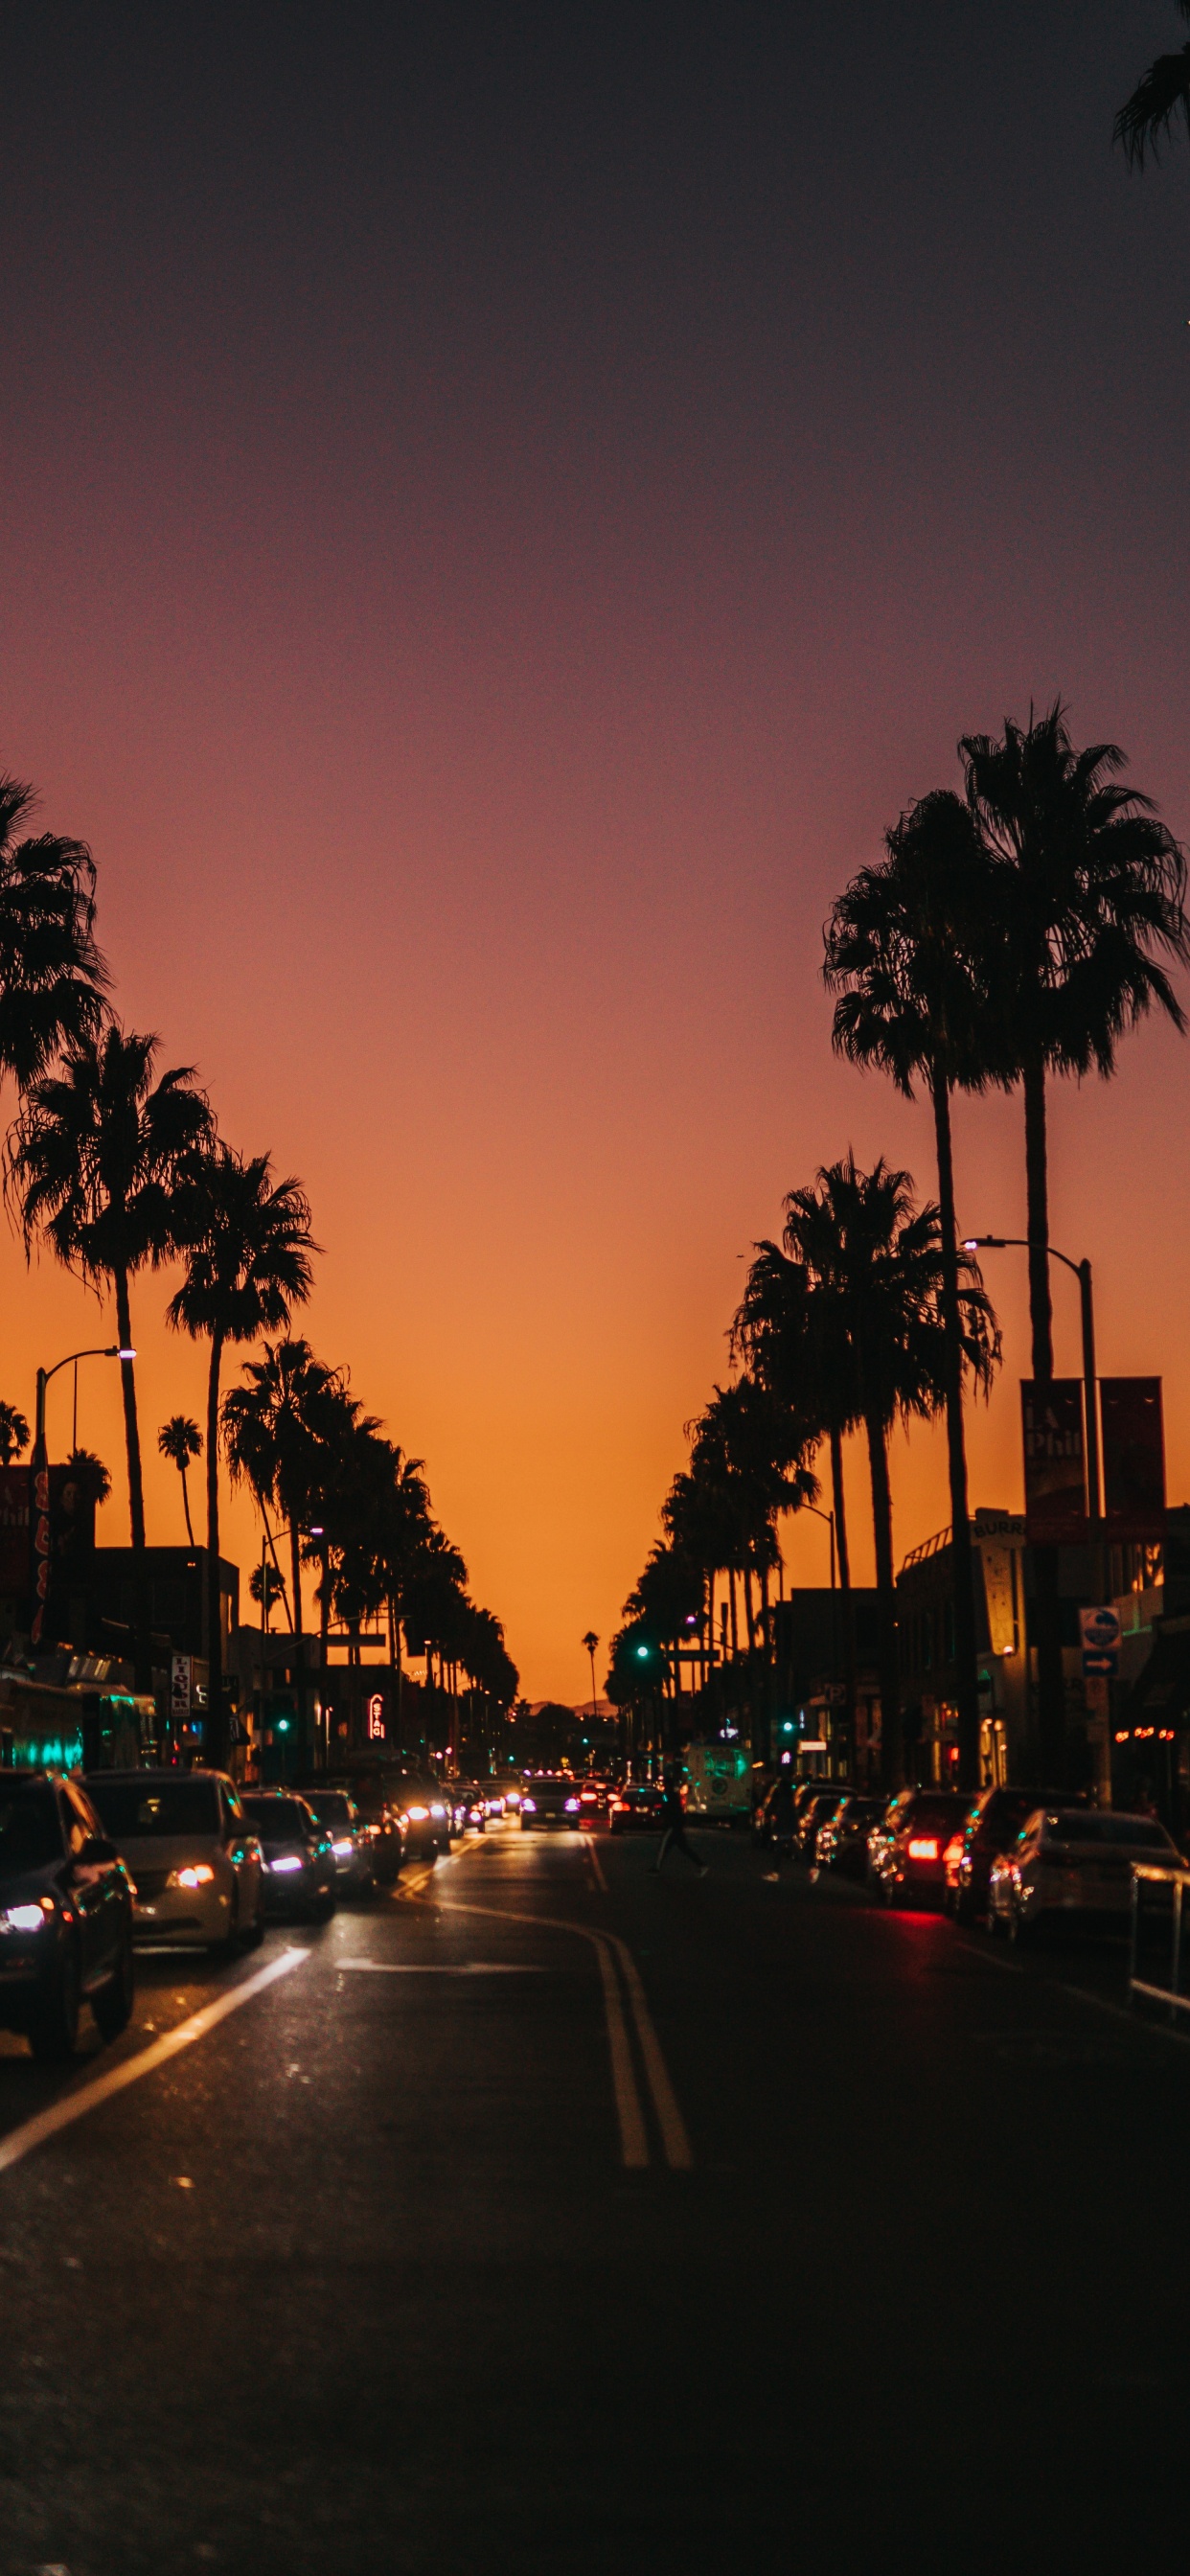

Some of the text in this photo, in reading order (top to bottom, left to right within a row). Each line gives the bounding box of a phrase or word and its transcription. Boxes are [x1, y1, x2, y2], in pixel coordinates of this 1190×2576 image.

[1026, 1406, 1059, 1429] LA
[1026, 1430, 1081, 1457] Phil
[0, 1506, 29, 1527] hil
[973, 1521, 1025, 1538] BURR
